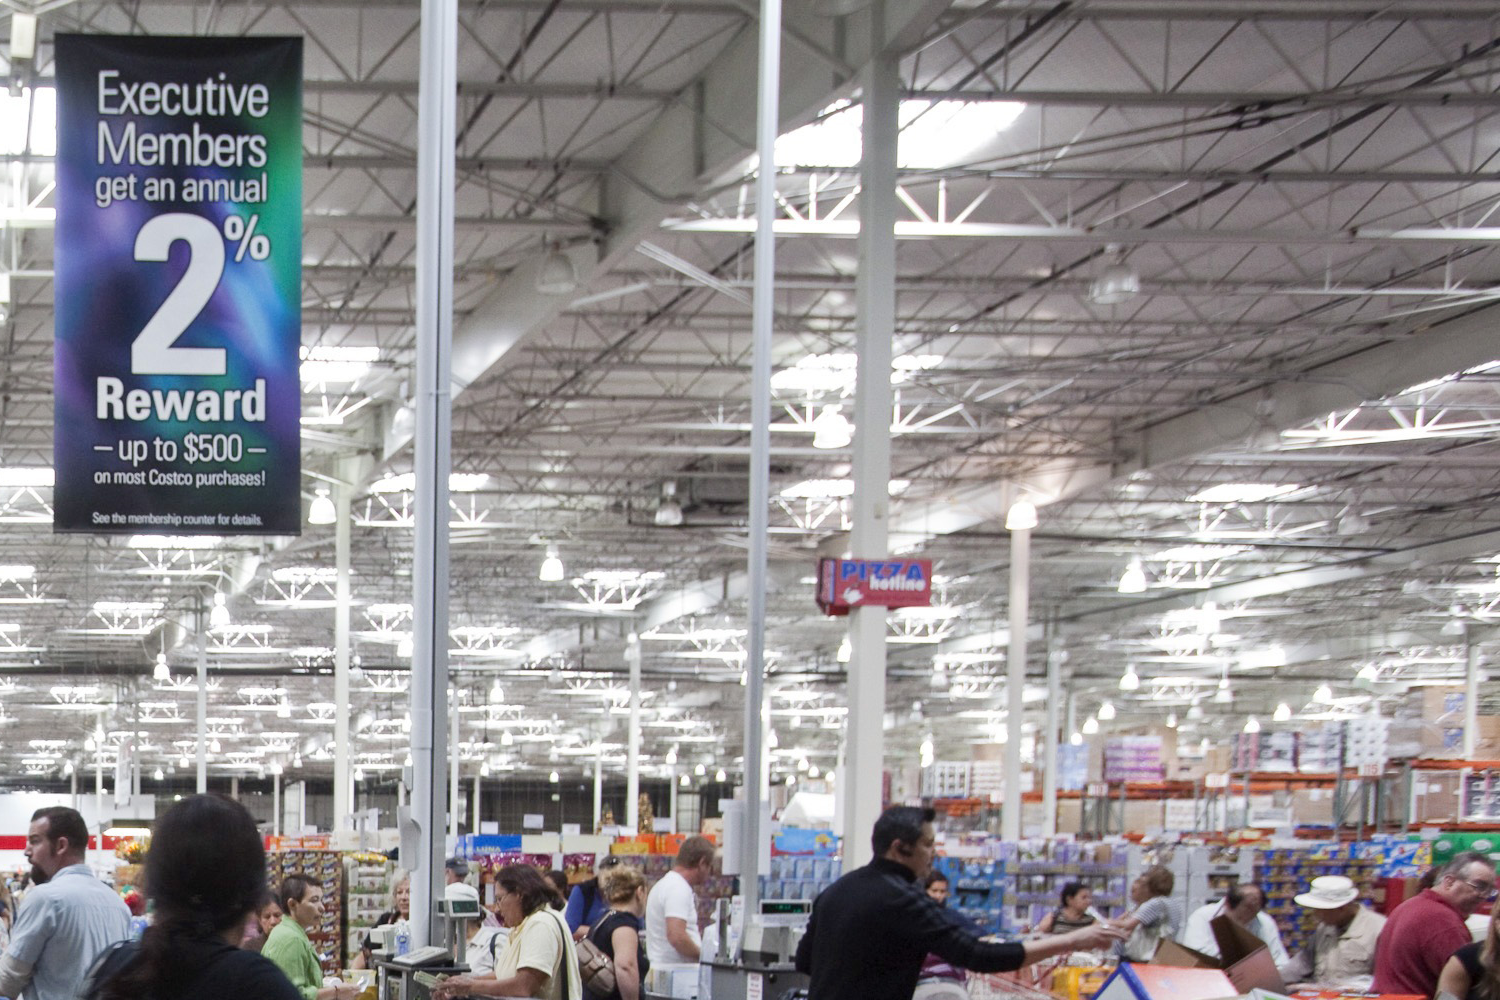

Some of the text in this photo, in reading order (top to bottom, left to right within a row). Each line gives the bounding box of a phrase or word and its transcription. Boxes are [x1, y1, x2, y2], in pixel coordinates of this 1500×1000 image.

[98, 70, 269, 117] Executive
[98, 120, 267, 167] Members
[96, 172, 267, 207] get an annual
[97, 377, 266, 422] Reward
[118, 432, 242, 467] up to $500
[94, 469, 266, 488] on most Costco purchases!
[92, 512, 263, 526] See the membership counter for details.
[841, 561, 922, 581] PIZZA
[869, 573, 926, 591] hotline
